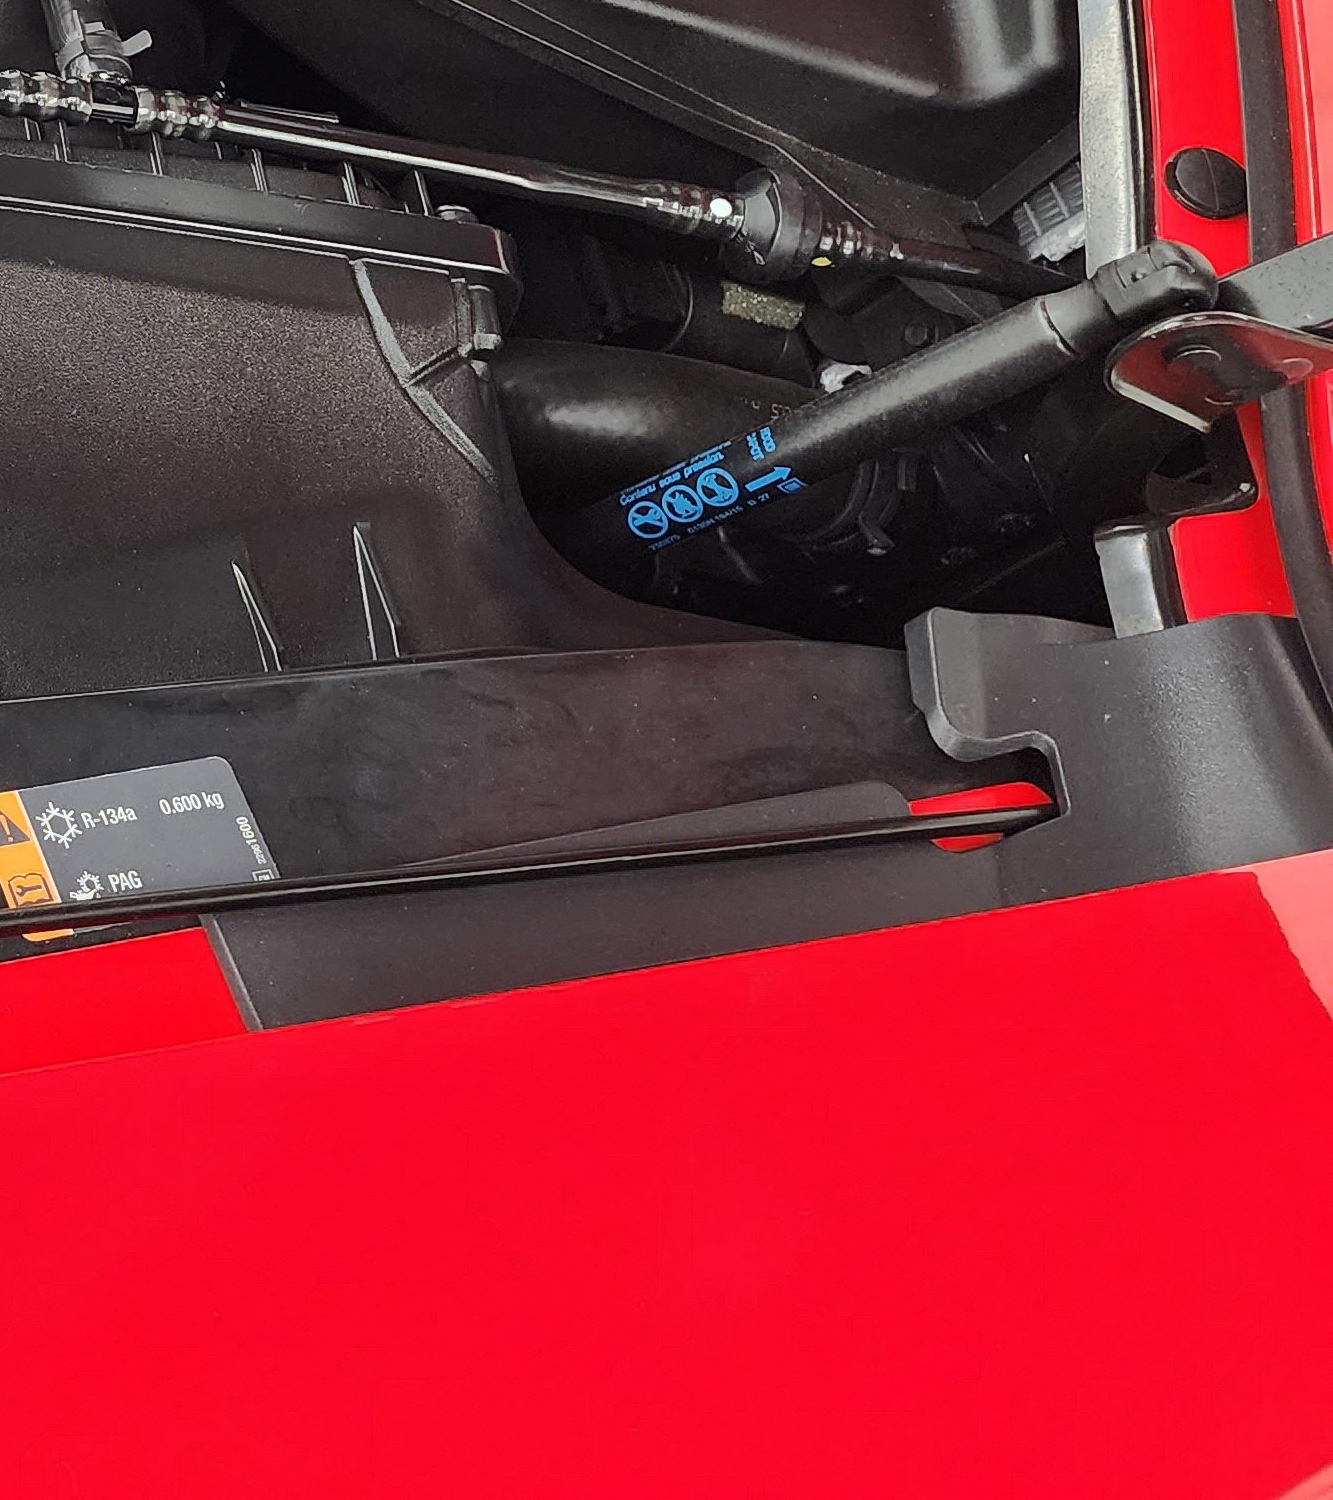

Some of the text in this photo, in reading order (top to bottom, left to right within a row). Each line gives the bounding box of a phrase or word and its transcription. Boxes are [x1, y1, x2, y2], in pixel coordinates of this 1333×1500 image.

[659, 471, 682, 490] sous
[81, 791, 225, 829] R-134a 0.600 kg
[108, 871, 144, 893] PAG
